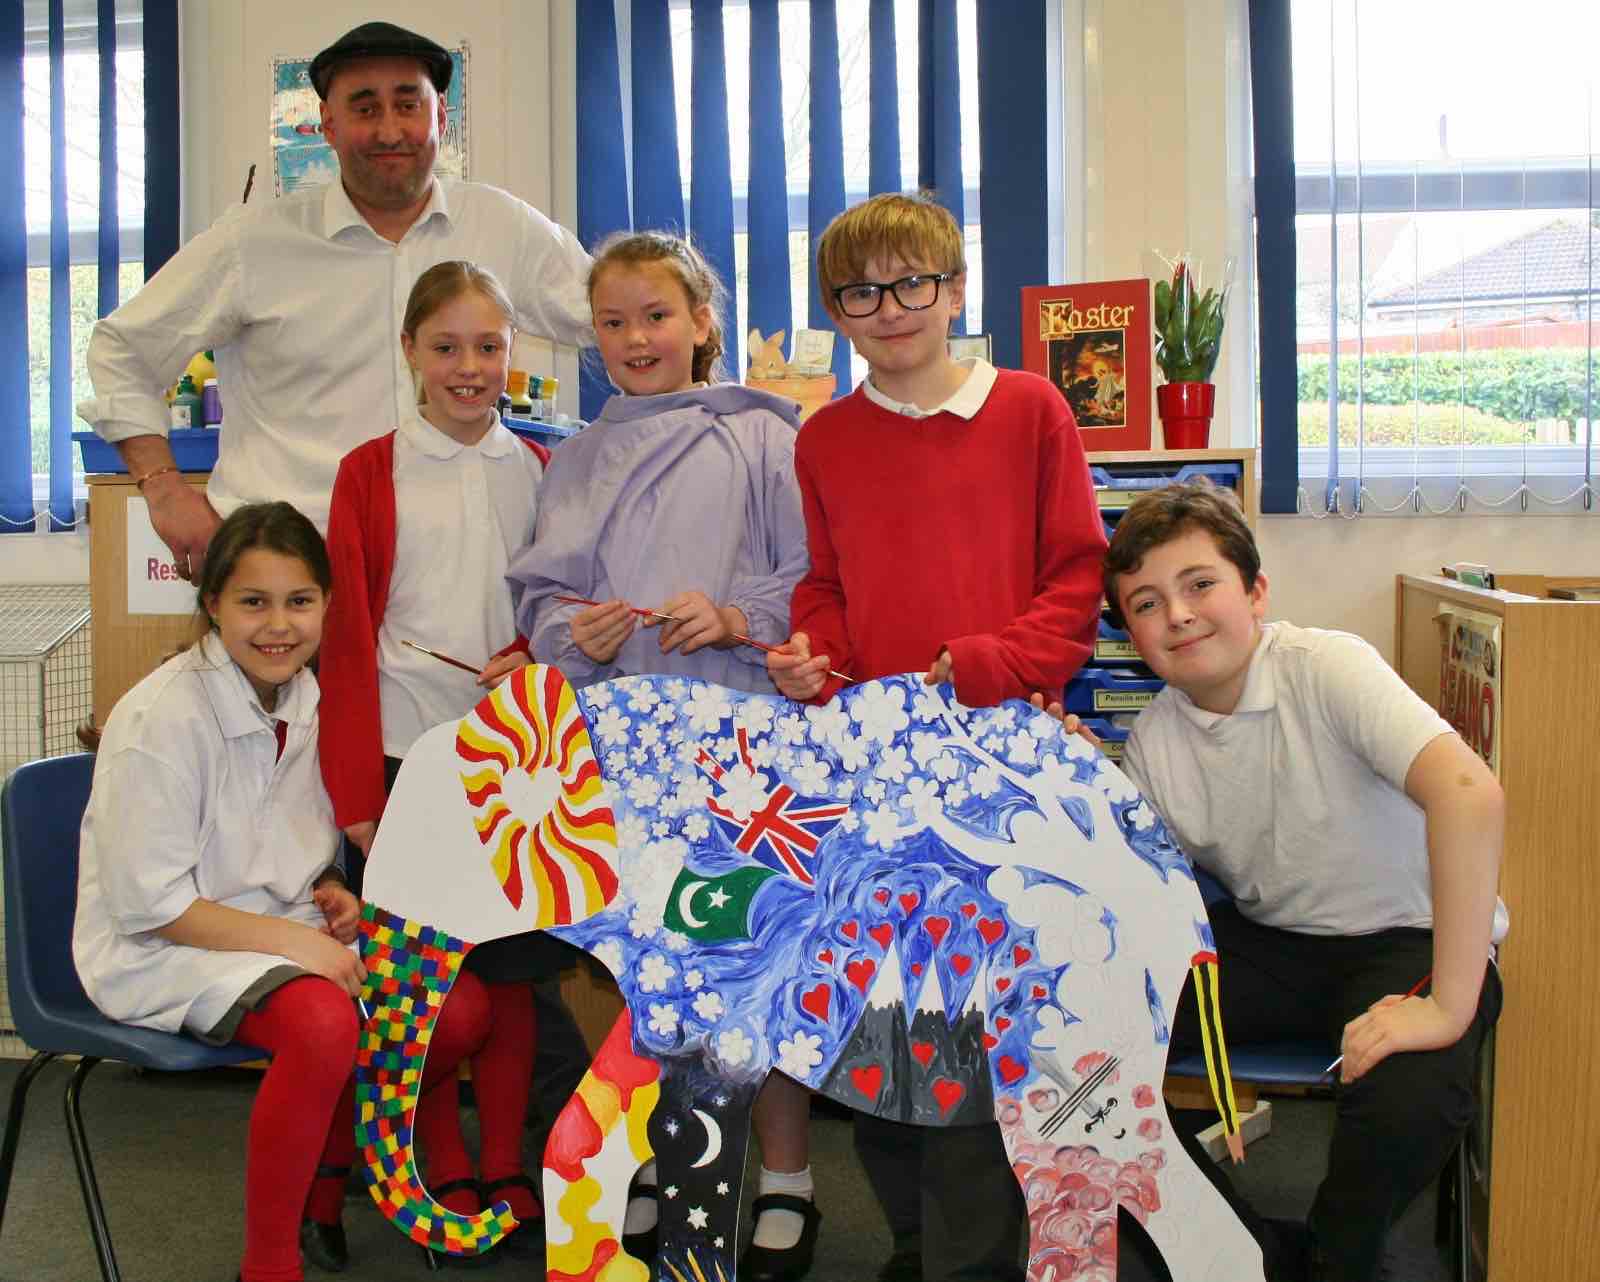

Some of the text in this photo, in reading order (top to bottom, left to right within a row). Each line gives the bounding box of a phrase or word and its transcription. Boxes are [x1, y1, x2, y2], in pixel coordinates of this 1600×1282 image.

[1041, 302, 1134, 336] Easter
[1105, 694, 1133, 702] Pencils
[1135, 694, 1151, 702] and
